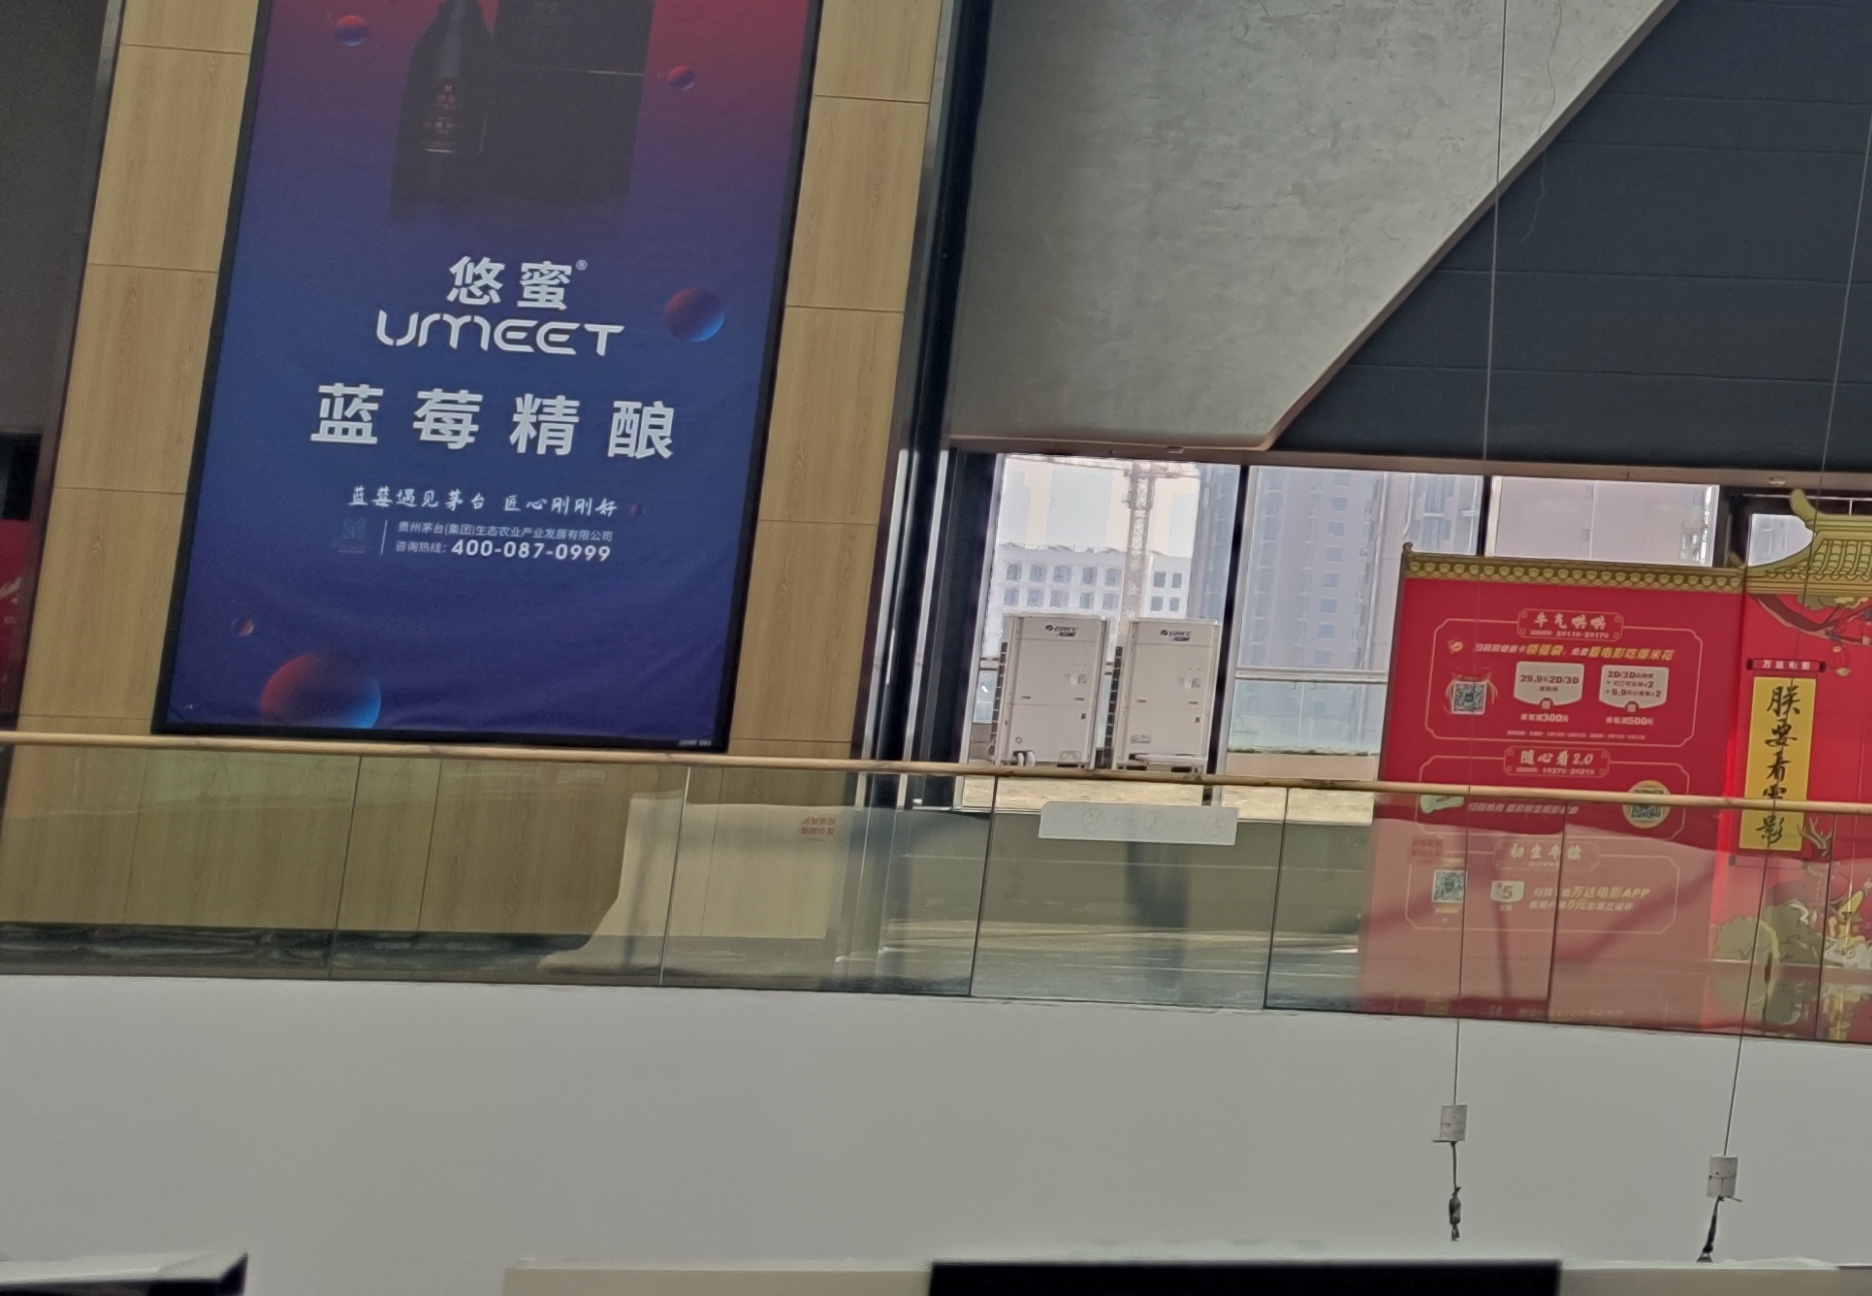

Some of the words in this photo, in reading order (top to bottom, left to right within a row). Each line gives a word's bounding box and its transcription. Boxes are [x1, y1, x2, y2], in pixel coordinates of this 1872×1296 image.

[310, 382, 676, 459] 蓝莓精酿
[348, 485, 485, 511] 蓝莓遇见茅台
[503, 494, 618, 517] 匠心刚刚好
[450, 539, 611, 562] 400-087-0999
